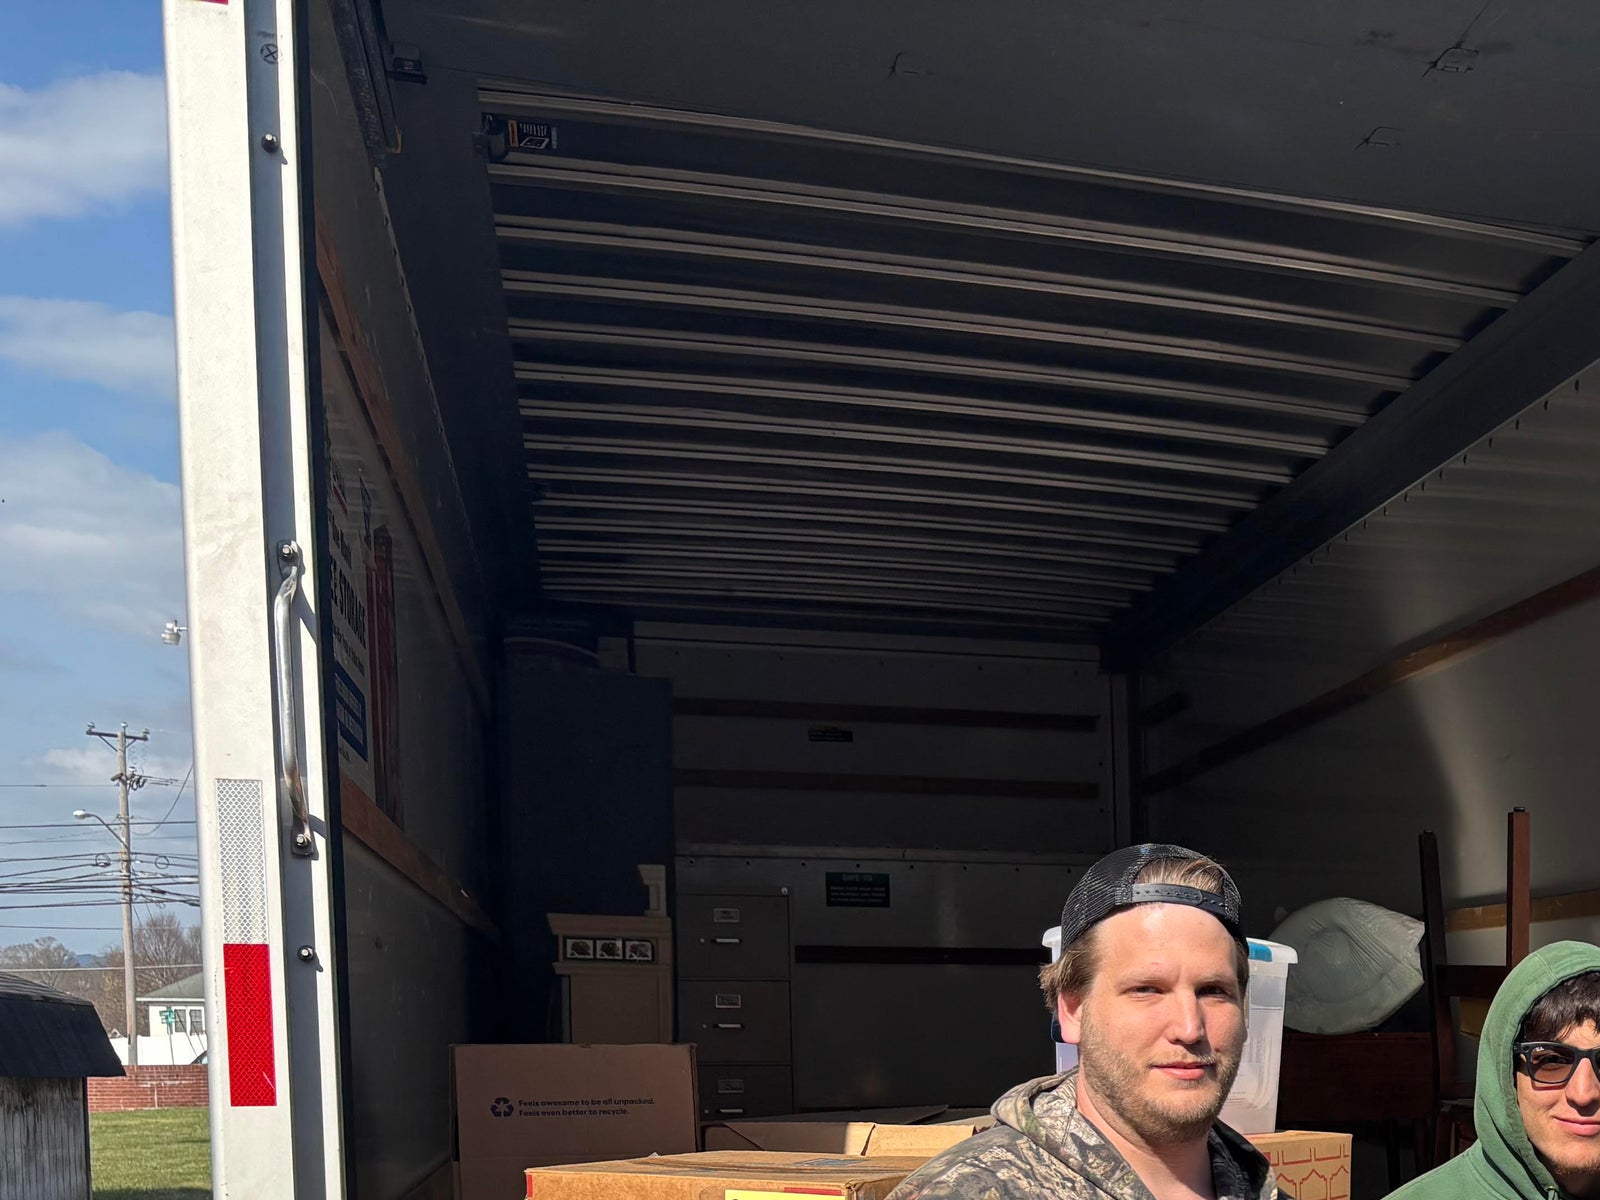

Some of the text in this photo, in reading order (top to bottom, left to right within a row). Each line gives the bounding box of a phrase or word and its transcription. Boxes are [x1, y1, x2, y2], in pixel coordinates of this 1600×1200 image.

[614, 1097, 655, 1106] unpacked.
[519, 1109, 540, 1117] Feels
[562, 1108, 587, 1116] better
[598, 1107, 630, 1117] recycle.
